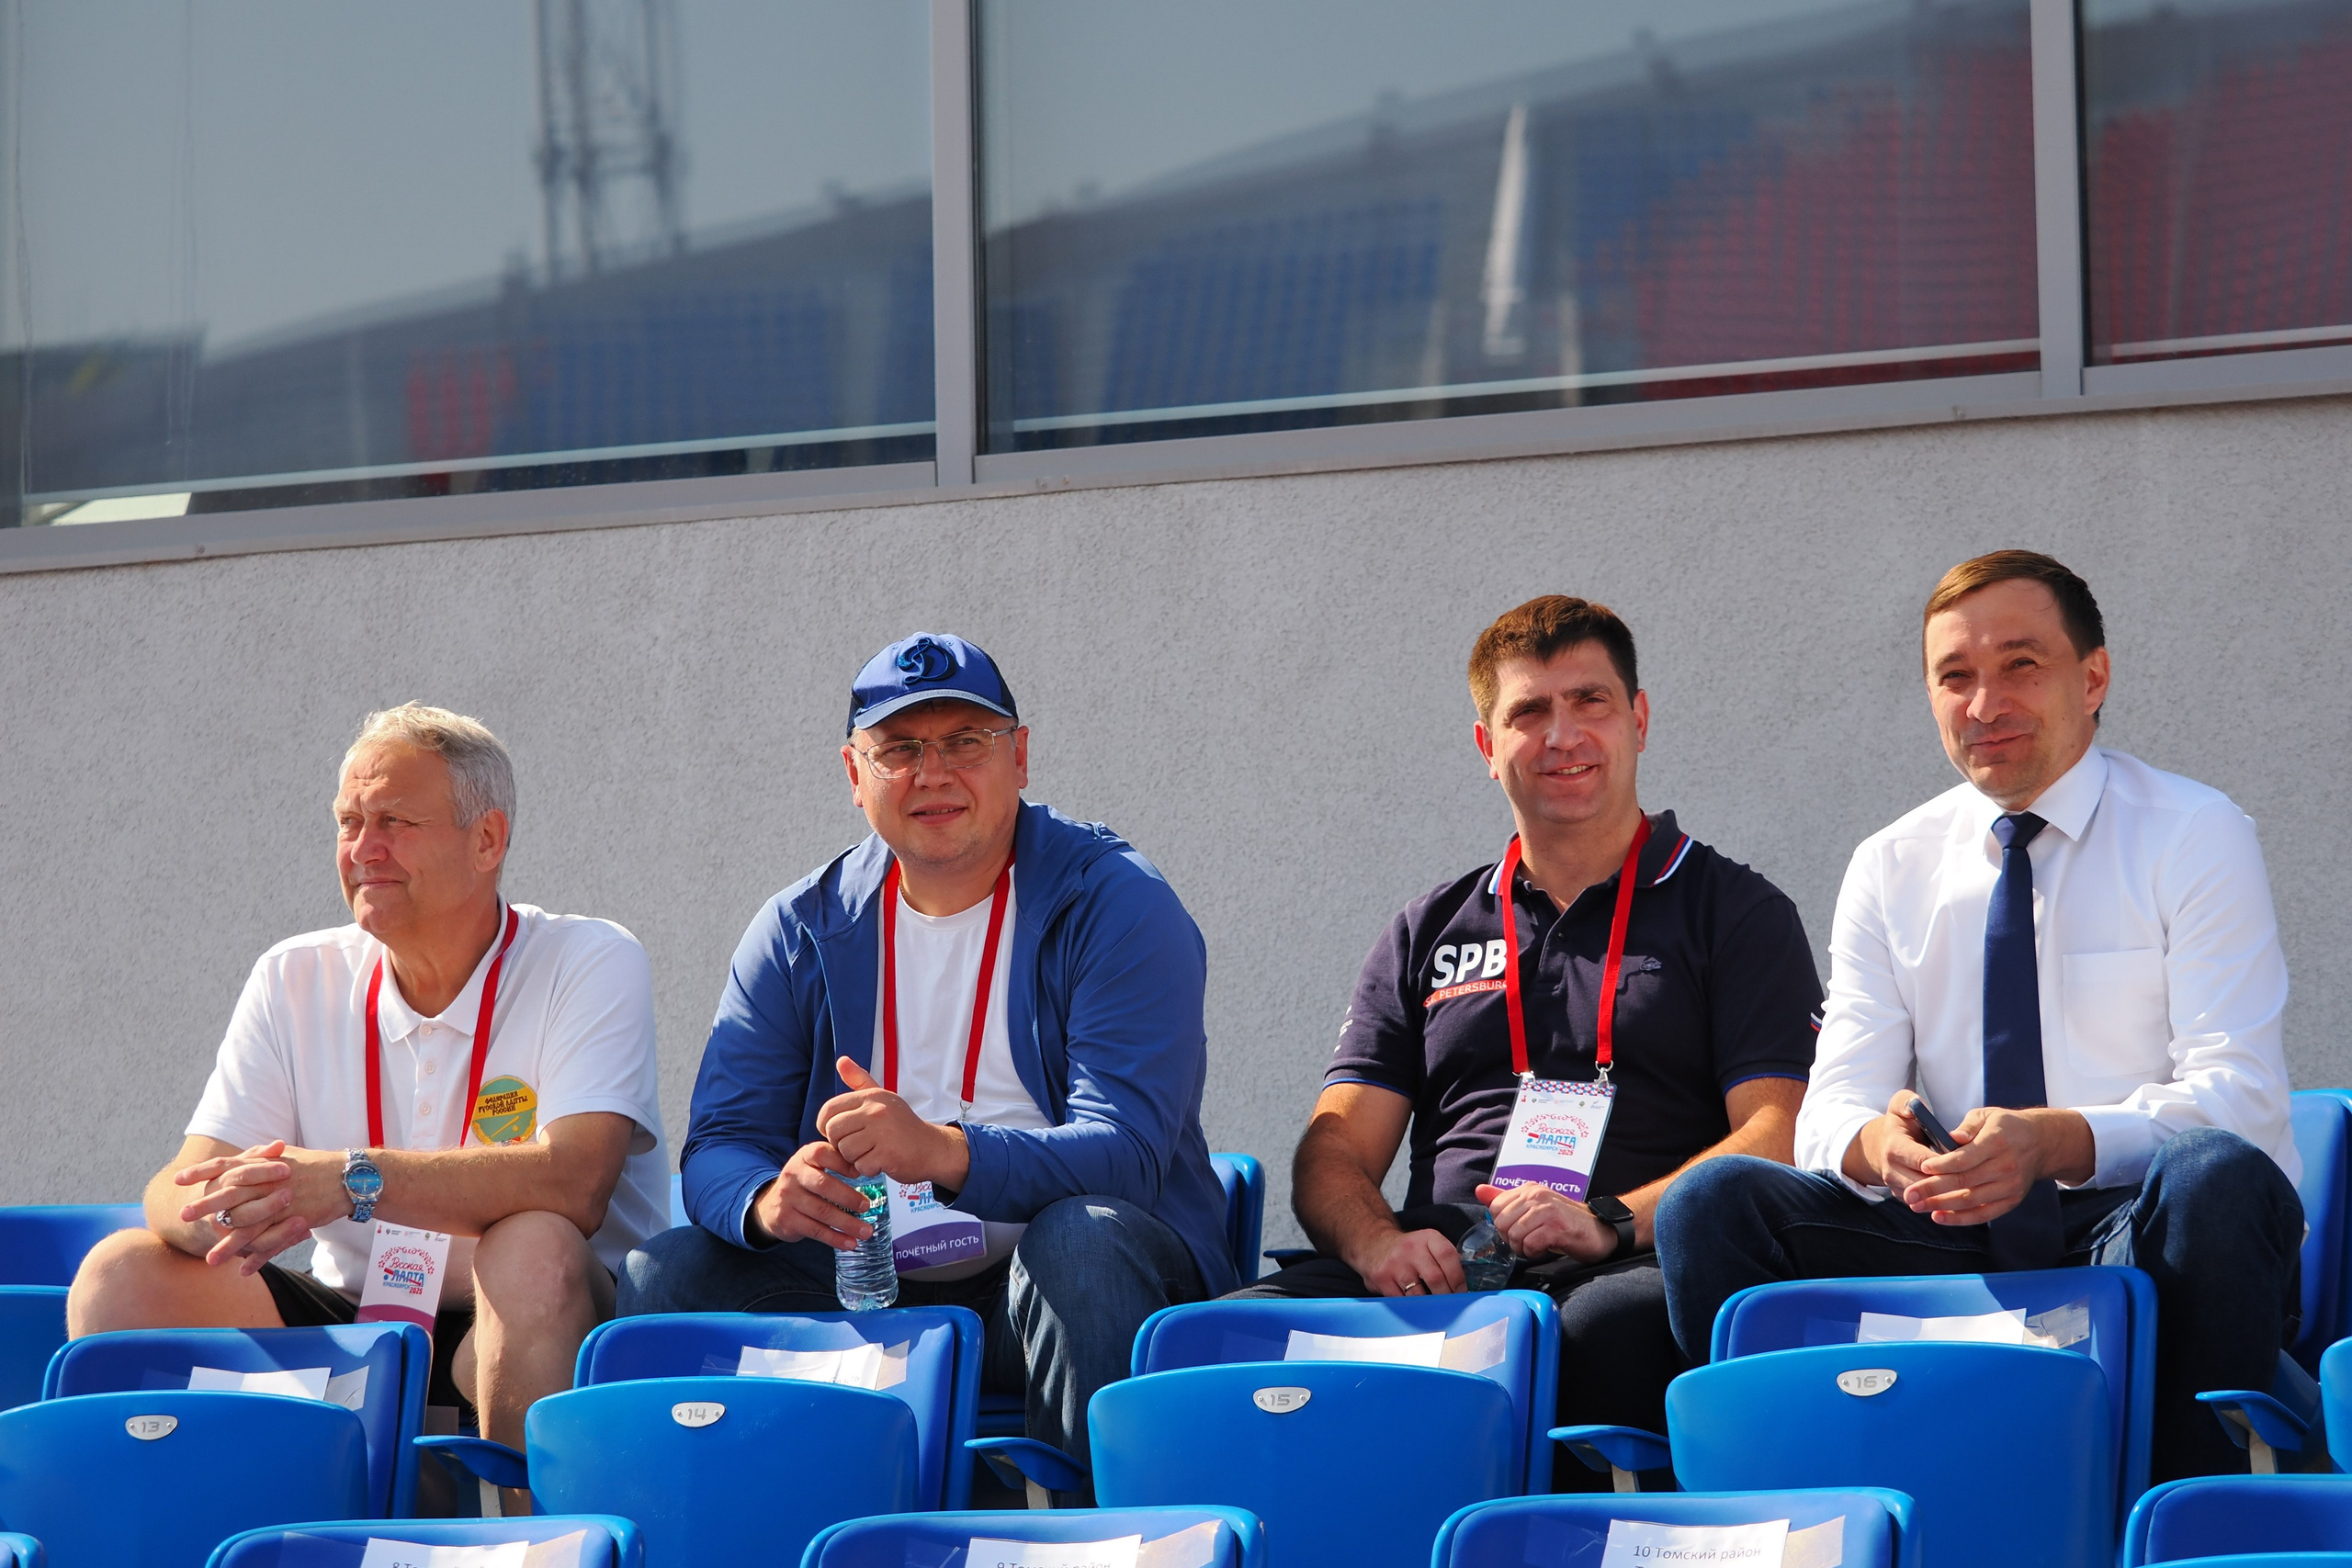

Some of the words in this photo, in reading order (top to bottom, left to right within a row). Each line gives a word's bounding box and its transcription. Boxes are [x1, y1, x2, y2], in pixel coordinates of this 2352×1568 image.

[1431, 939, 1507, 987] SPB
[1495, 1177, 1548, 1188] ПОЧЁТЙ
[1550, 1182, 1581, 1192] ГОСТЬ
[896, 1239, 946, 1259] ПОЧЁТНЫЙ
[949, 1235, 979, 1248] ГОСТЬ
[1856, 1376, 1877, 1388] 16
[1271, 1394, 1290, 1405] 15
[688, 1408, 707, 1419] 14
[142, 1422, 159, 1432] 13
[1634, 1545, 1650, 1557] 10
[1656, 1547, 1716, 1560] Томский
[1720, 1547, 1761, 1561] район
